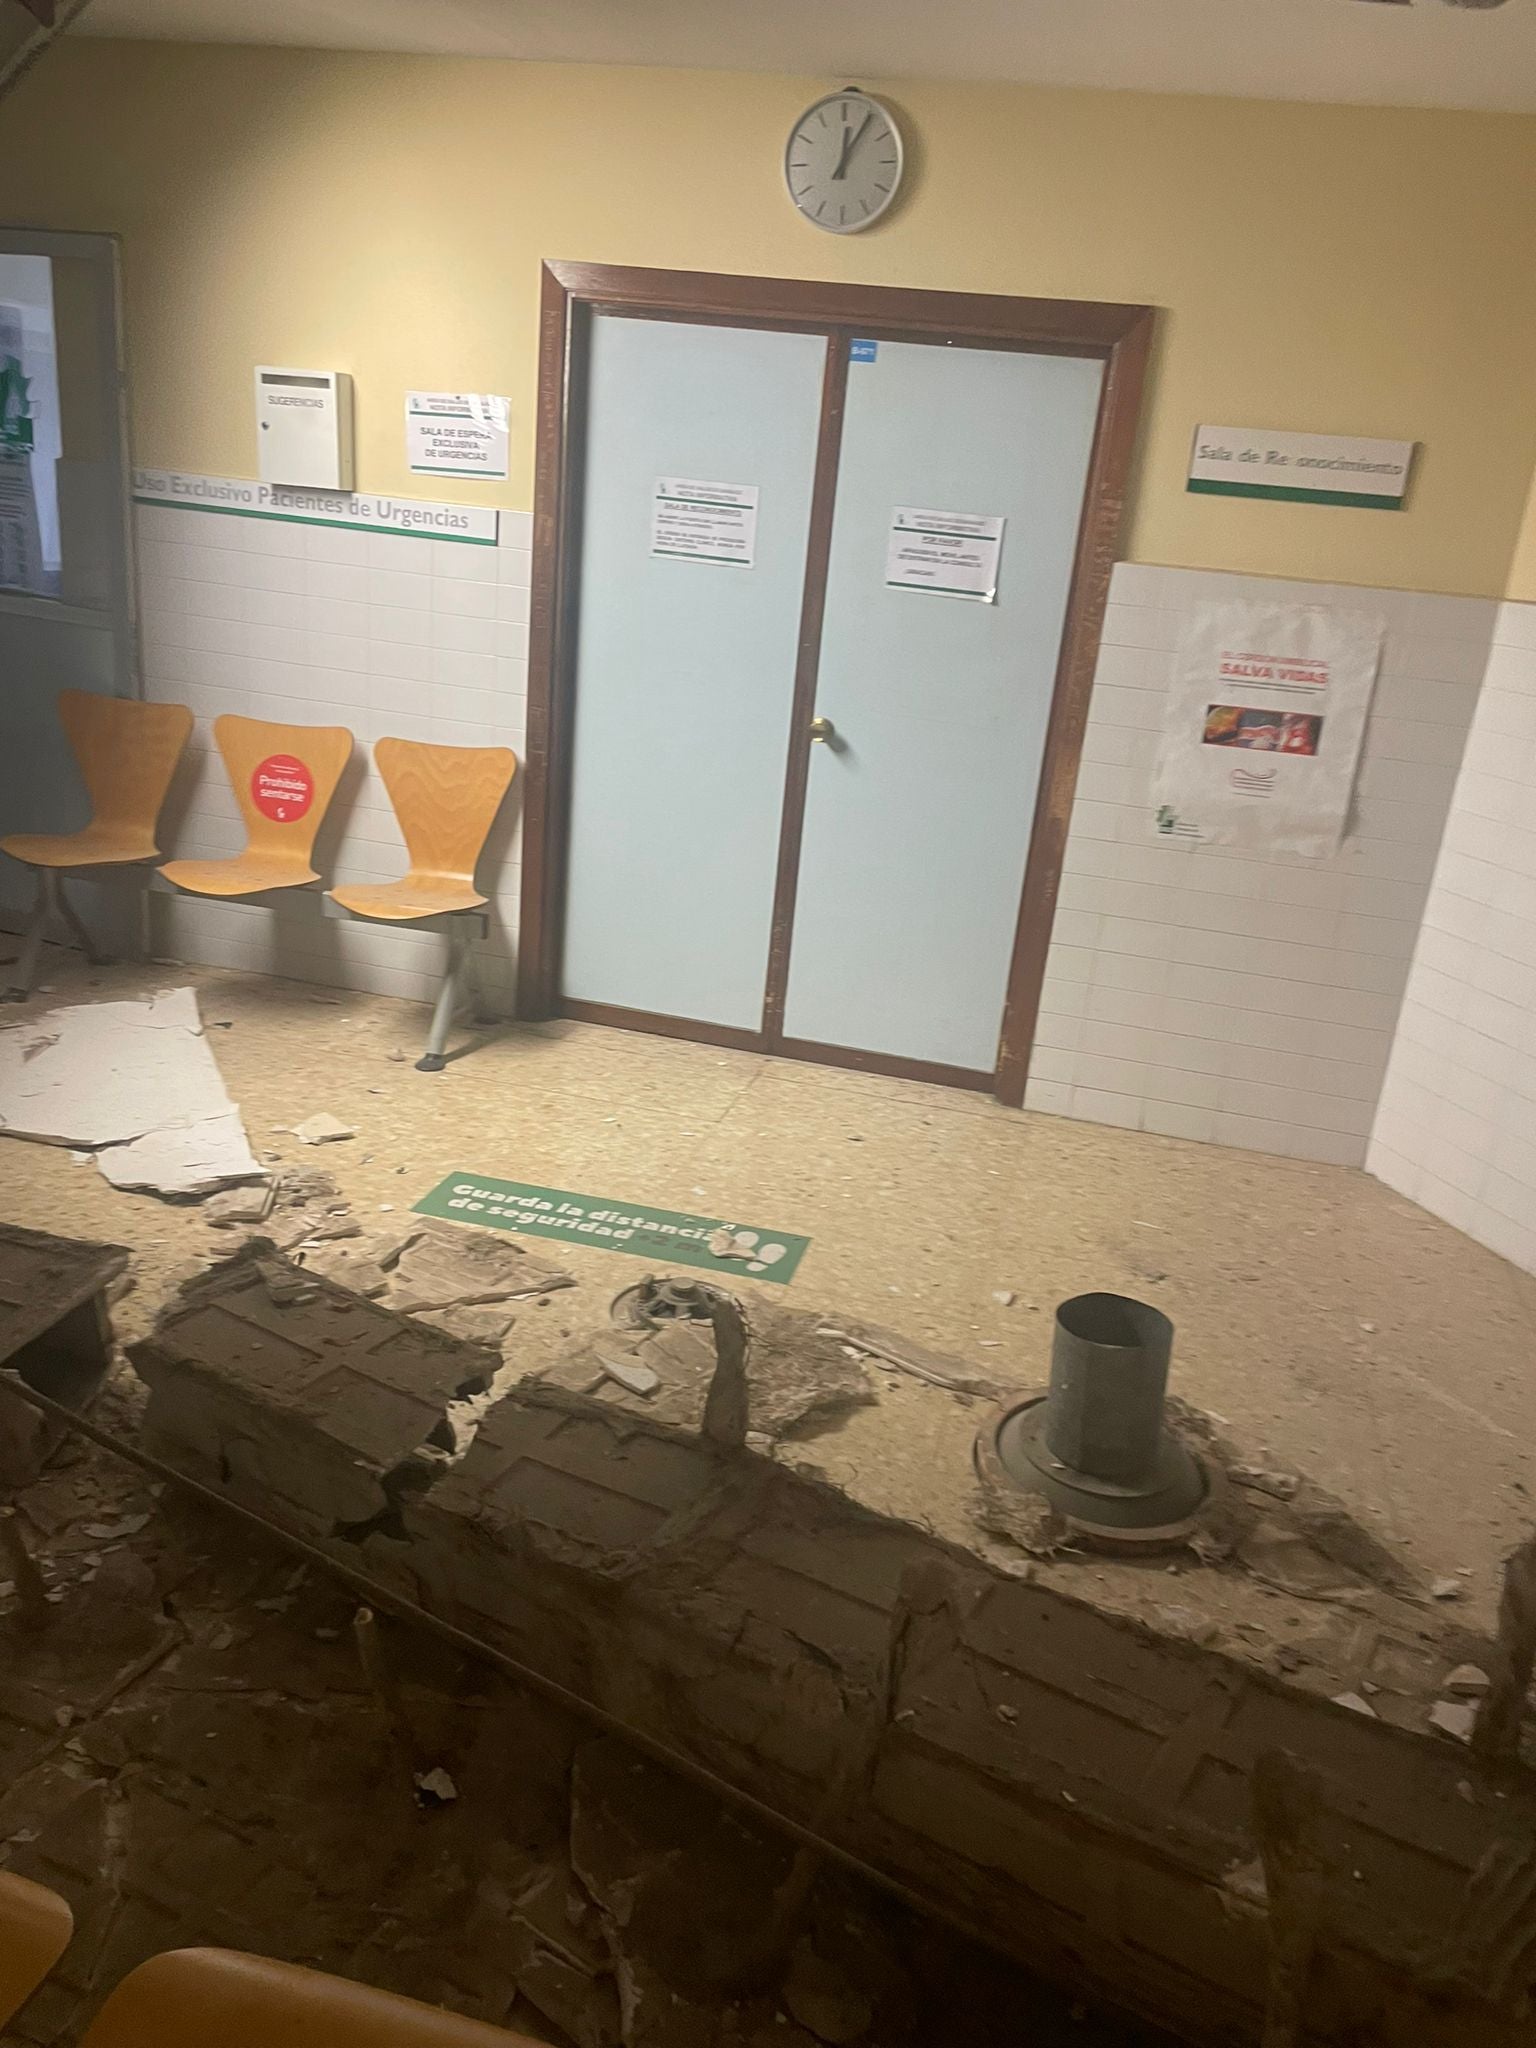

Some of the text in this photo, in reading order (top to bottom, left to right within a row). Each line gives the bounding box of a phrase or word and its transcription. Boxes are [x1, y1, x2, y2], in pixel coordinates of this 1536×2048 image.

[420, 426, 442, 436] SALA
[443, 428, 456, 437] DE
[432, 438, 480, 449] EXCLUSIVA
[1197, 444, 1233, 461] Sala
[1238, 447, 1261, 464] de
[424, 448, 488, 461] DE URGENCIAS
[133, 472, 469, 529] Uso Exclusivo Pacientes de Urgencias
[1220, 662, 1329, 685] SALVA VIDAS
[452, 1184, 554, 1211] Guarda
[555, 1202, 585, 1217] la
[447, 1197, 486, 1211] de
[485, 1205, 637, 1241] seguridad
